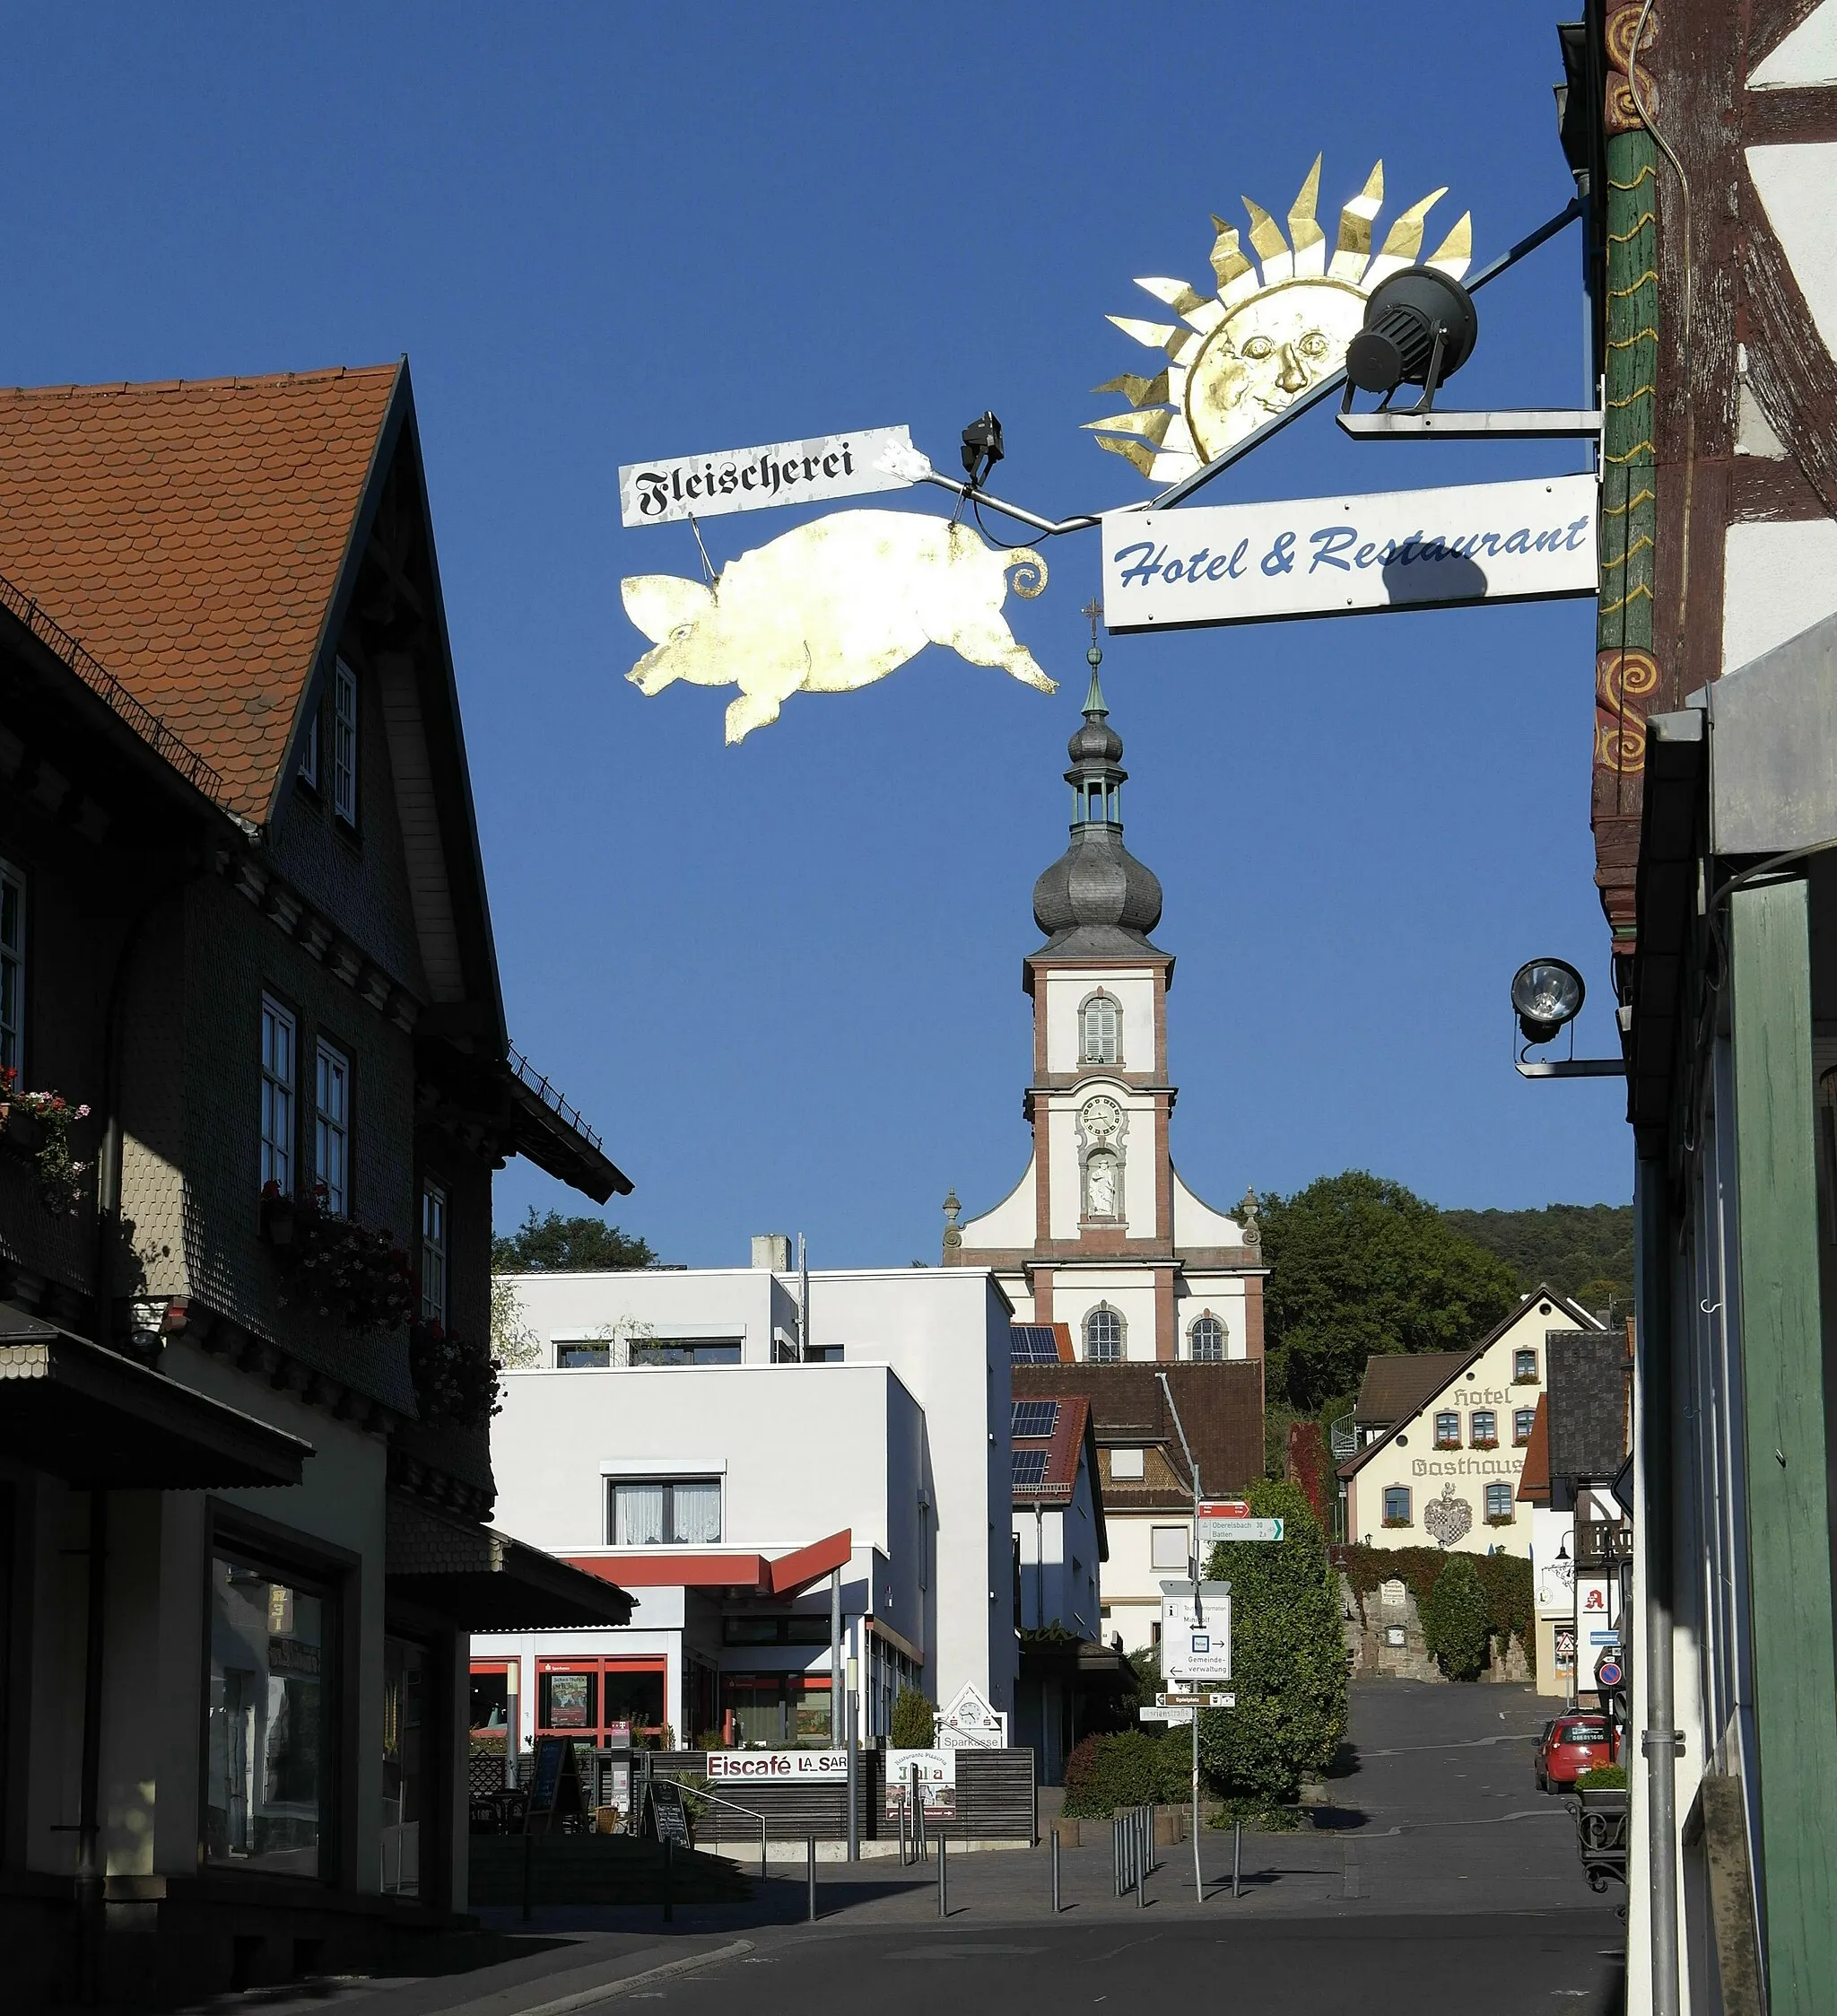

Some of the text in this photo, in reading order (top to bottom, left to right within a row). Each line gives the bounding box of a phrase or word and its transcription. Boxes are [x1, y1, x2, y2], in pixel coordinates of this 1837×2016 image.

[635, 441, 856, 518] Fleischerei
[1113, 514, 1590, 589] Hotel & Restaurant
[1453, 1386, 1513, 1406] Hotel
[1412, 1457, 1524, 1477] Gasthaus
[1188, 1666, 1227, 1674] verwaltung
[944, 1737, 998, 1748] Sparkasse
[708, 1755, 791, 1776] Eiscafé
